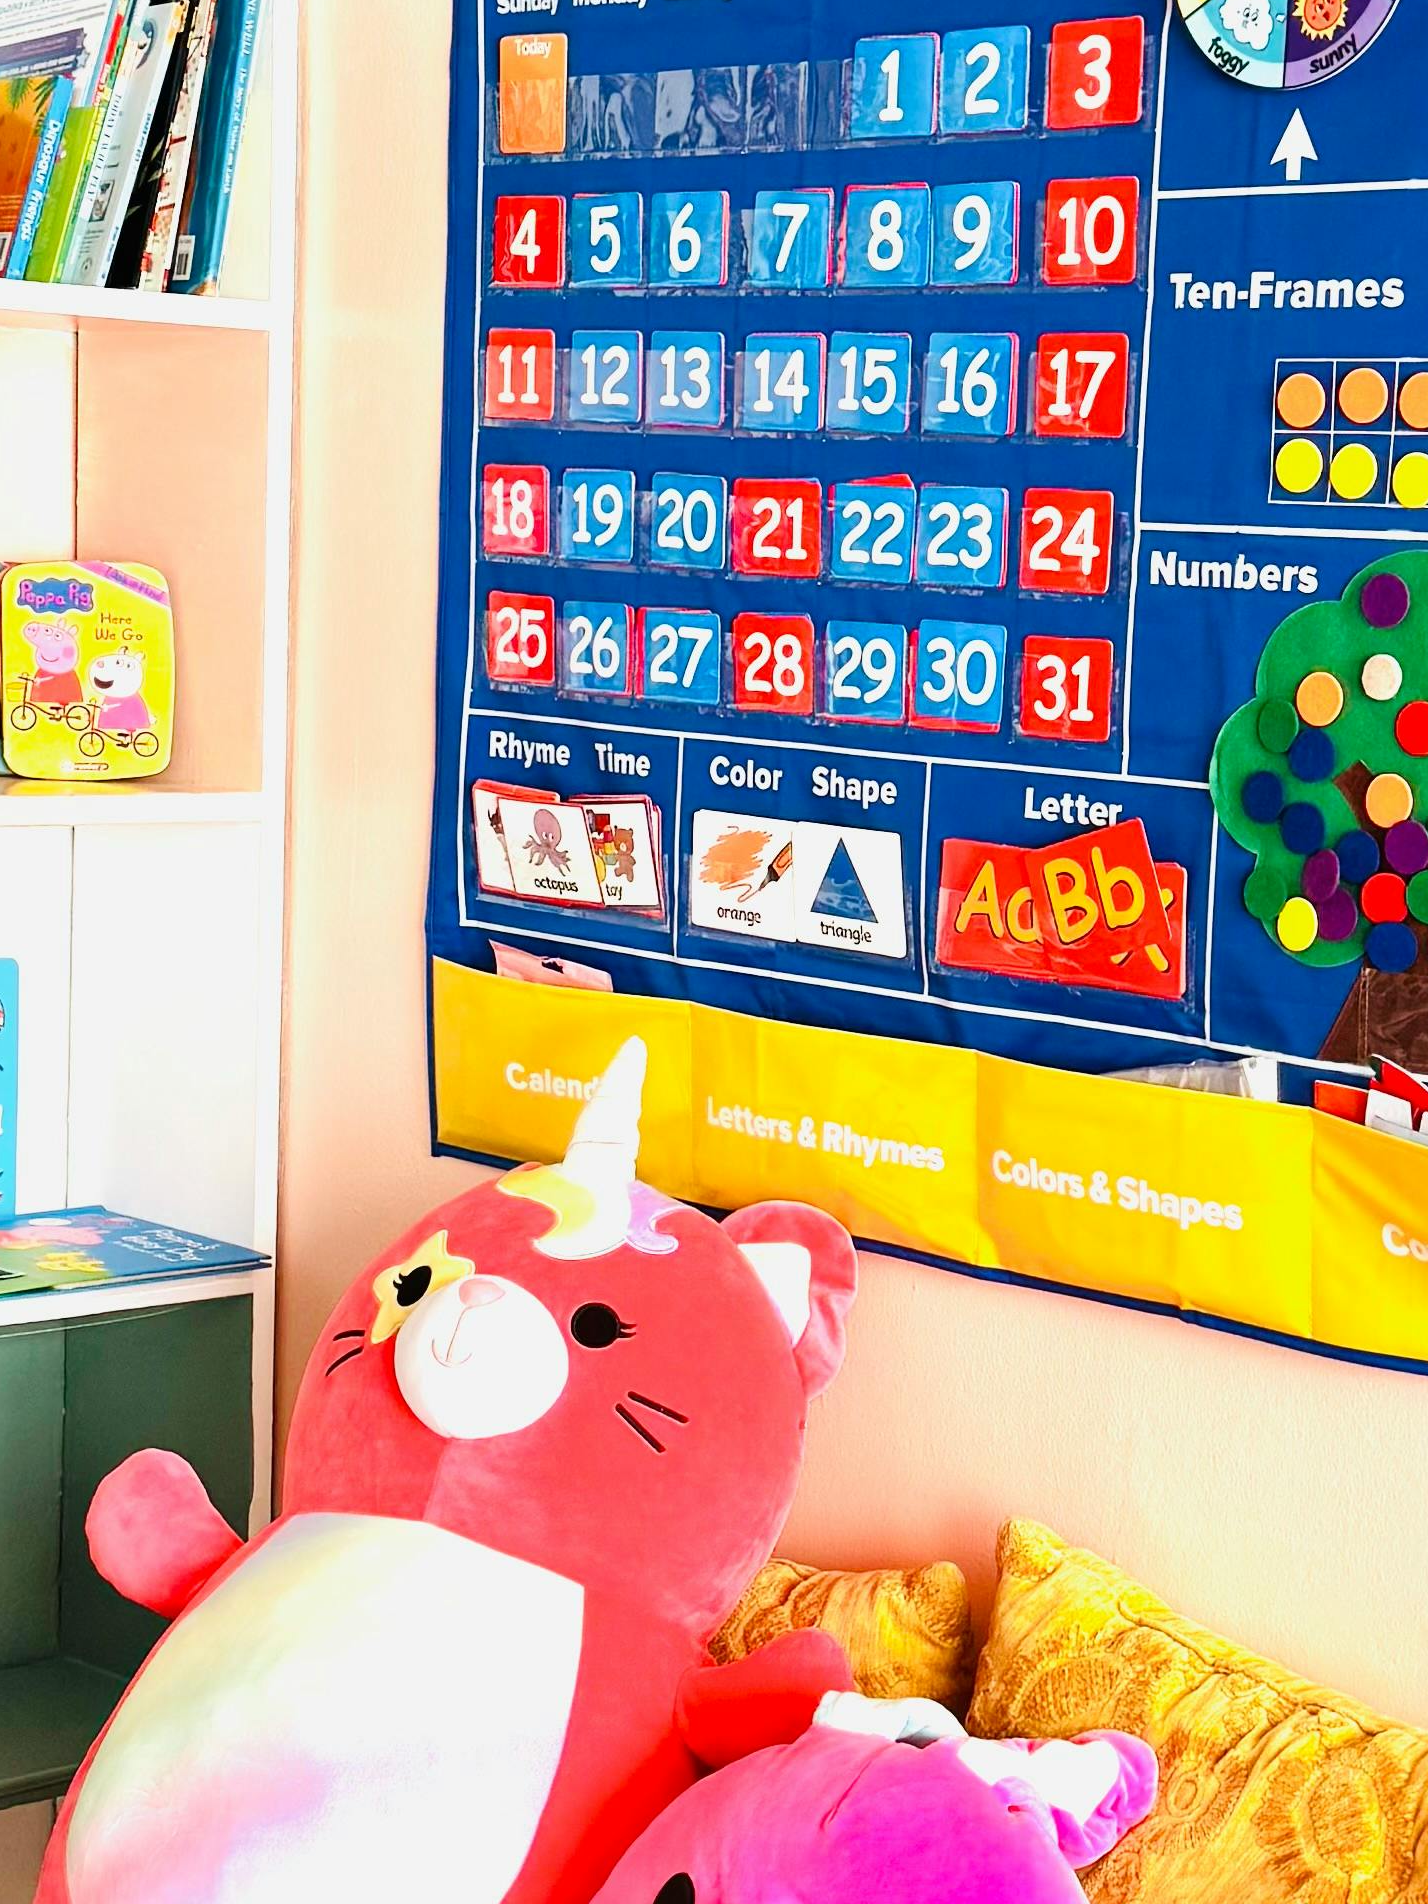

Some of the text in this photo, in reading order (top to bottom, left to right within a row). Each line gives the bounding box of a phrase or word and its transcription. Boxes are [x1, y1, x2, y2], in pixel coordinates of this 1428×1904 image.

[515, 36, 552, 59] Today
[1207, 35, 1250, 79] foggy
[1309, 33, 1358, 75] sunny
[878, 34, 1111, 123] 1 2 3
[20, 120, 61, 241] Dinosaur Friends
[510, 195, 1125, 273] 4 5 6 7 8 9 10
[1170, 270, 1405, 310] Ten-Frames
[497, 339, 1116, 421] 11 12 13 14 15 16 17
[491, 477, 1102, 576] 18 19 20 21 22 23 24
[20, 580, 65, 608] Peppa
[68, 583, 91, 608] Pig
[1150, 551, 1319, 594] Numbers
[95, 628, 143, 641] We Go
[100, 612, 132, 625] Here
[496, 607, 1094, 723] 25 26 27 28 29 30 31
[488, 729, 651, 779] Rhyme Time
[709, 753, 898, 809] Color Shape
[1024, 786, 1123, 827] Letter
[534, 876, 579, 893] octopus
[605, 883, 623, 901] toy
[1043, 846, 1145, 944] Bb
[717, 904, 762, 926] orange
[820, 920, 873, 944] triangle
[506, 1062, 602, 1101] Calend
[707, 1095, 945, 1174] Letters & Rhymes
[992, 1149, 1244, 1231] Colors & Shapes
